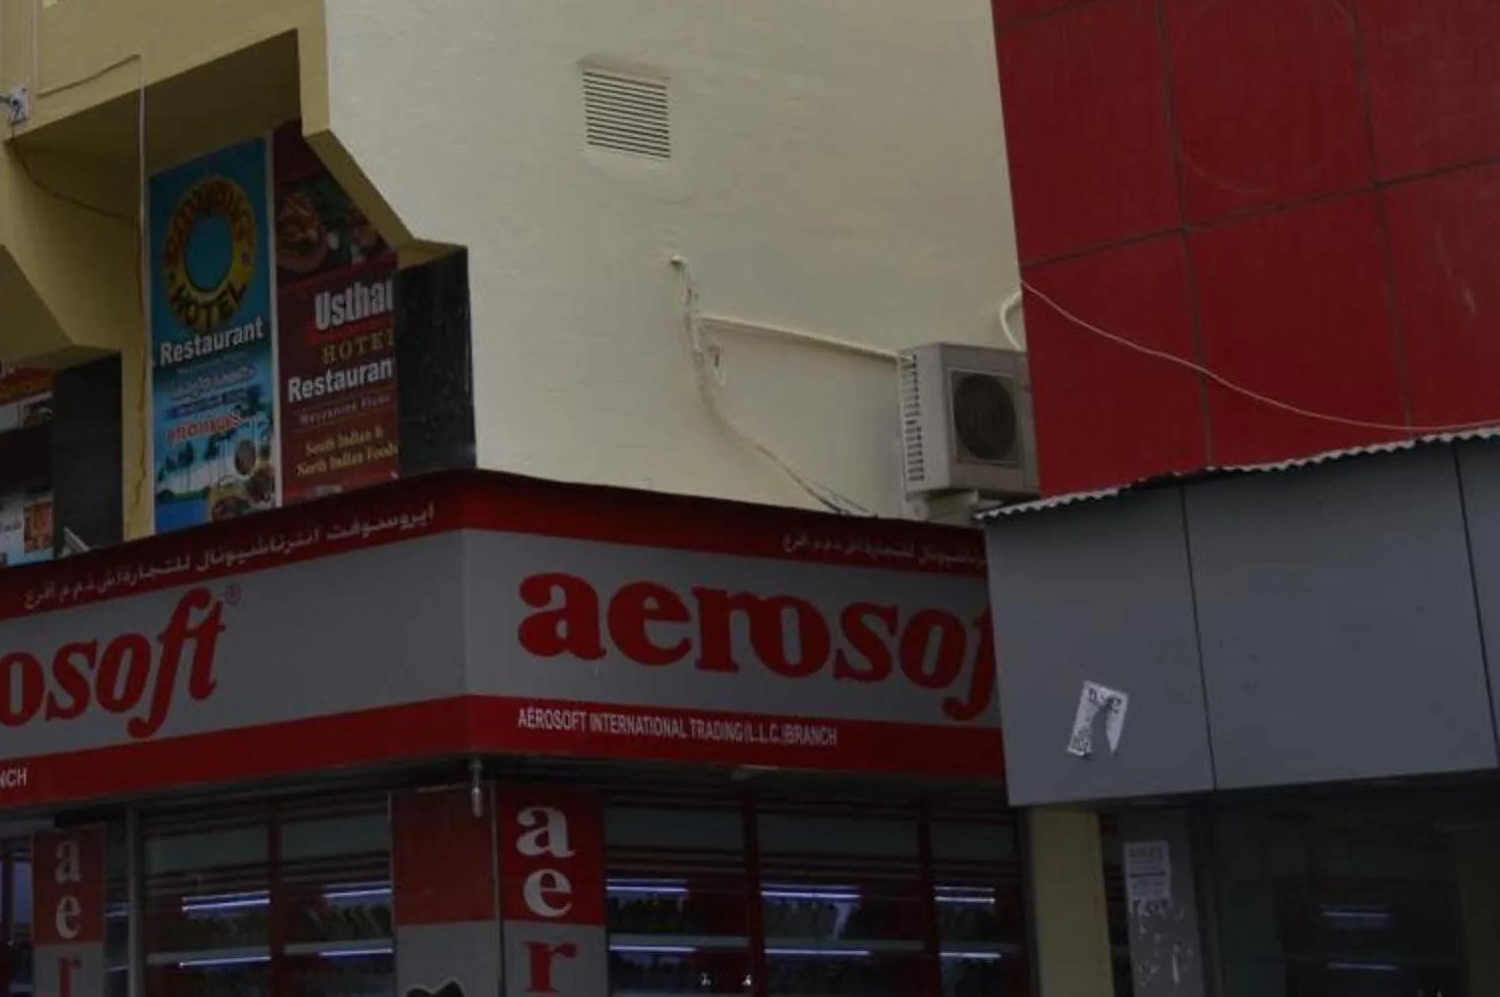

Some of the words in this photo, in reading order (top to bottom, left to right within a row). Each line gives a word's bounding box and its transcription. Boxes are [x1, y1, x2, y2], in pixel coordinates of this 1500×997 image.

[160, 315, 265, 367] Restaurant
[287, 357, 396, 404] Restauran
[518, 572, 996, 722] aerosof
[516, 707, 587, 733] AEROSOFT
[588, 712, 688, 740] INTERNATIONAL
[688, 716, 743, 743] TRADING
